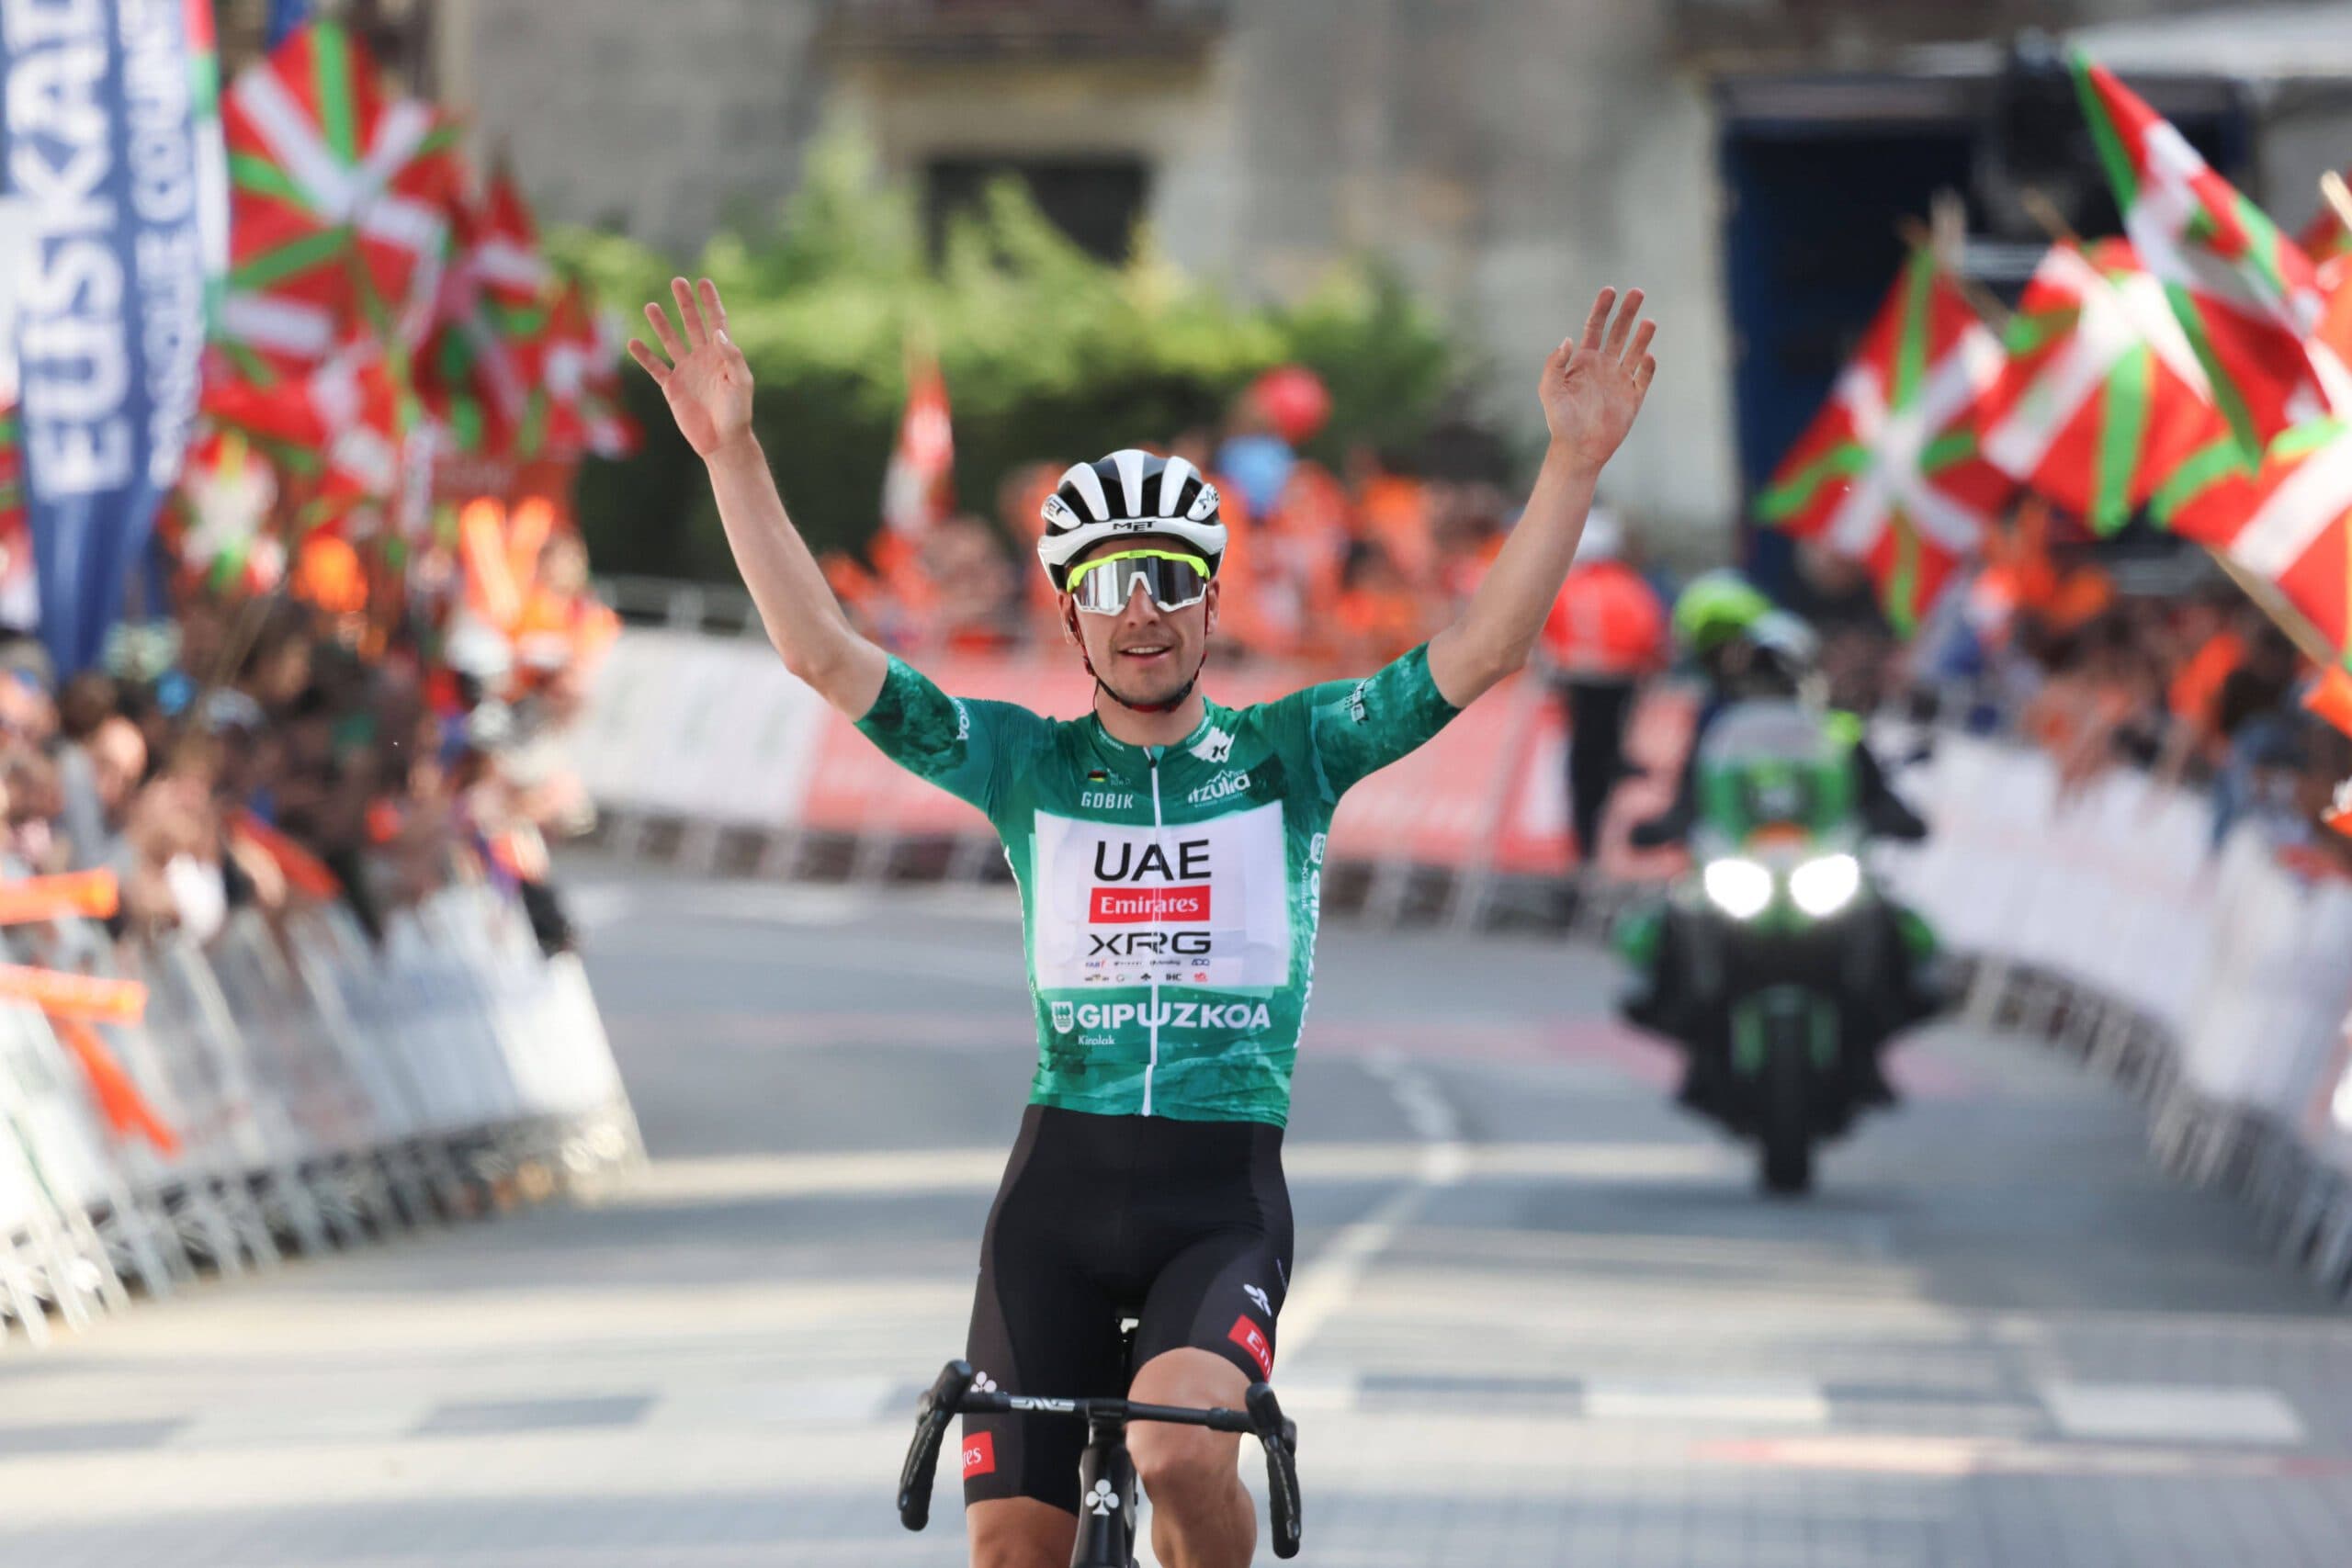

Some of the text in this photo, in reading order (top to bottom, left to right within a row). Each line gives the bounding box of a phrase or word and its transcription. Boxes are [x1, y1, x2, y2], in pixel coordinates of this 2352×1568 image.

[1113, 520, 1156, 532] MET
[1080, 791, 1134, 809] GOBIK
[1094, 839, 1212, 882] UAE
[1100, 896, 1199, 915] Emirates
[1088, 931, 1212, 956] XRG
[1077, 1002, 1272, 1029] GIPUZKOA
[1078, 1034, 1115, 1046] Kirolak
